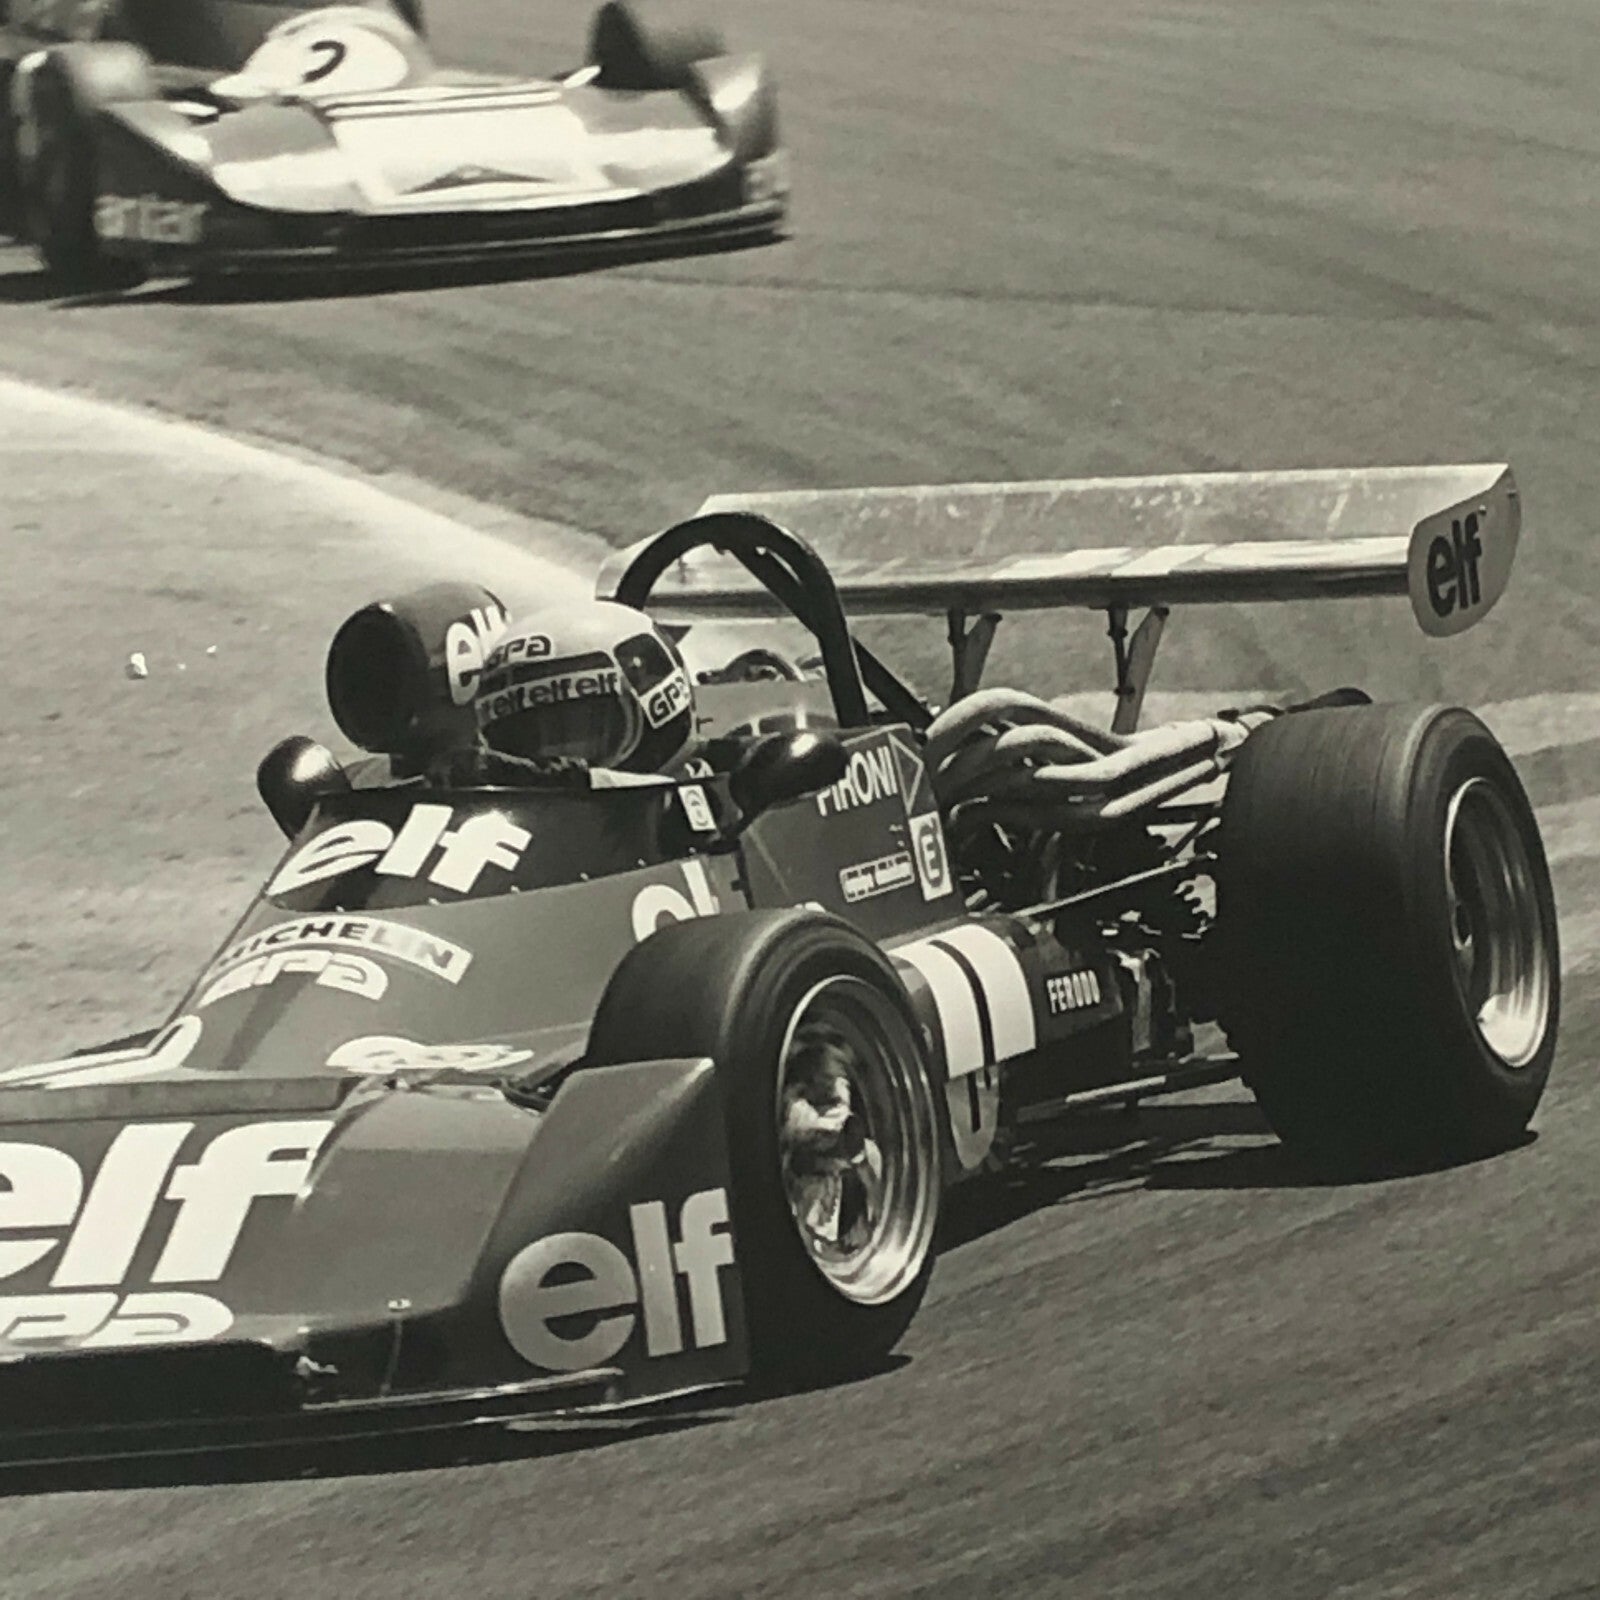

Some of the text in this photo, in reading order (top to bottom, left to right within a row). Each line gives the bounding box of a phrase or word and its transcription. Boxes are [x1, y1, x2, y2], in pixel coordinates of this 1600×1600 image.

[1426, 511, 1483, 618] elf
[265, 803, 533, 897] elf
[498, 1186, 736, 1372] elf
